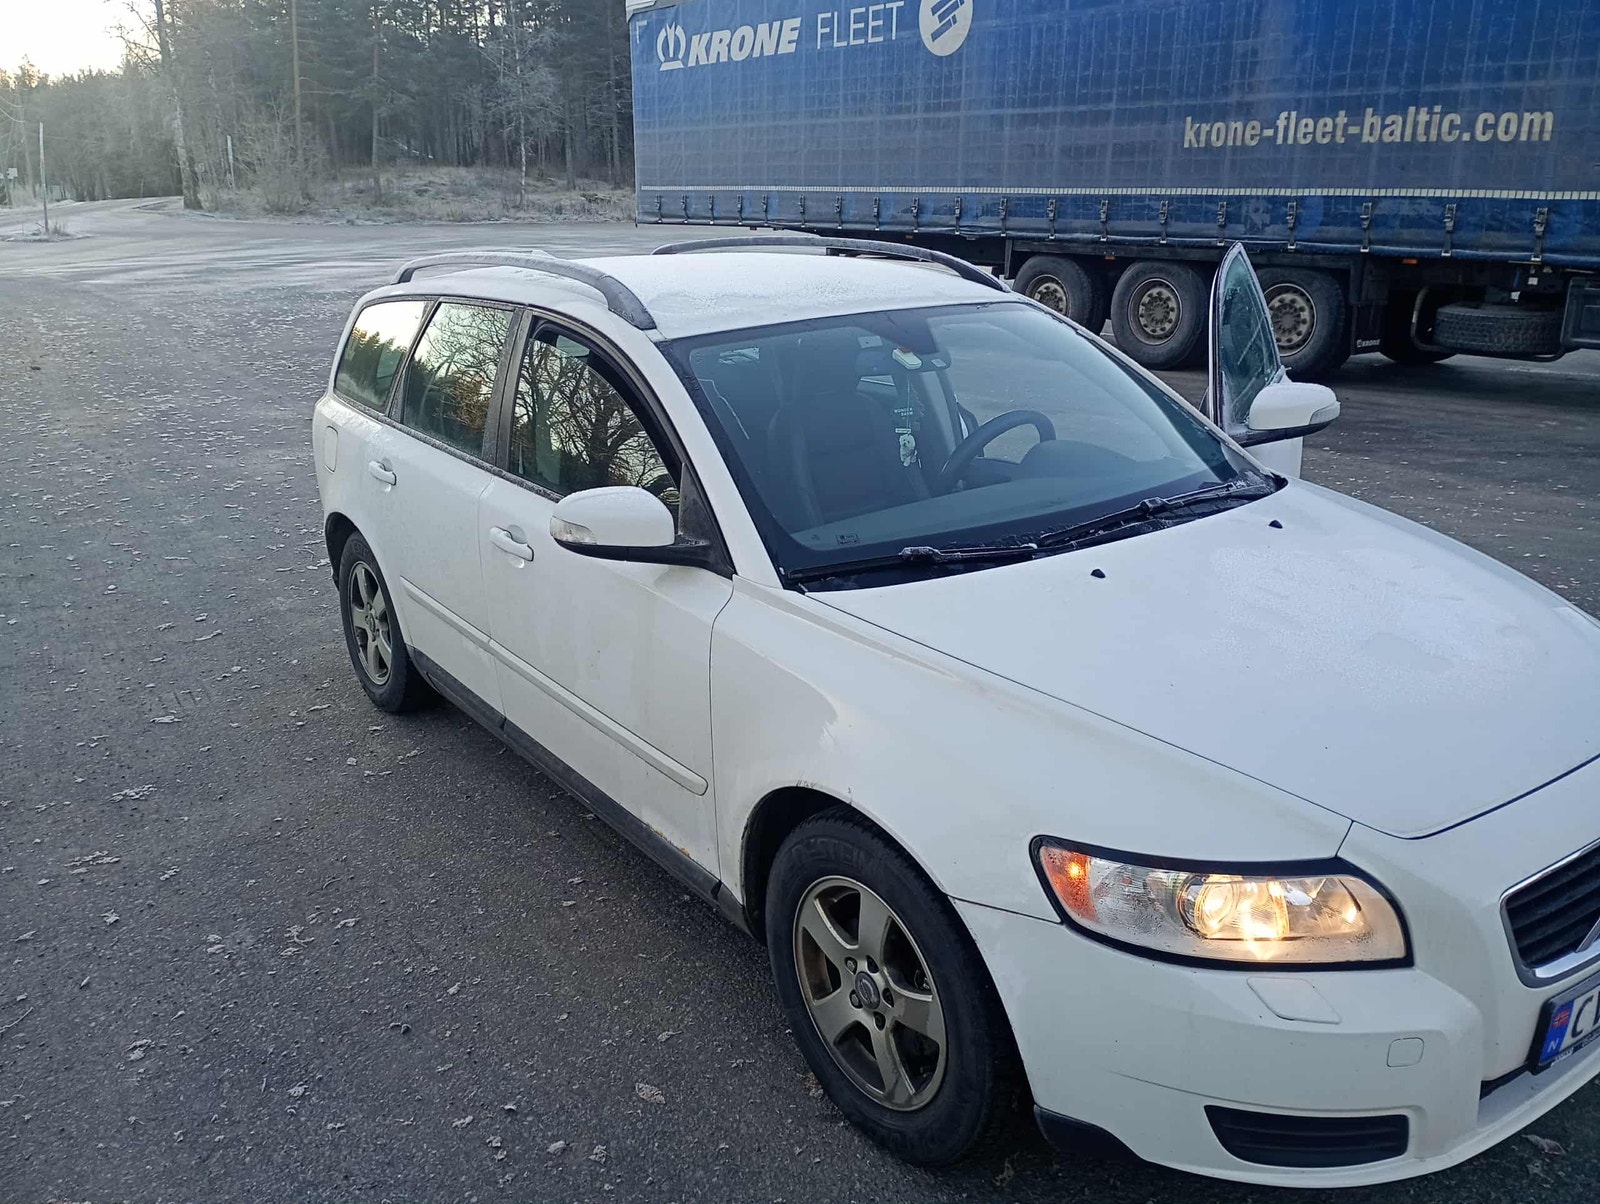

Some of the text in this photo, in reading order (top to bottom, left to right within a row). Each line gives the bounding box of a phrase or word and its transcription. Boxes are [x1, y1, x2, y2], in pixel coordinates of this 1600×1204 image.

[688, 1, 905, 67] KRONE FLEET
[1184, 105, 1554, 148] krone-fleet-baltic.com
[1547, 1038, 1560, 1053] N
